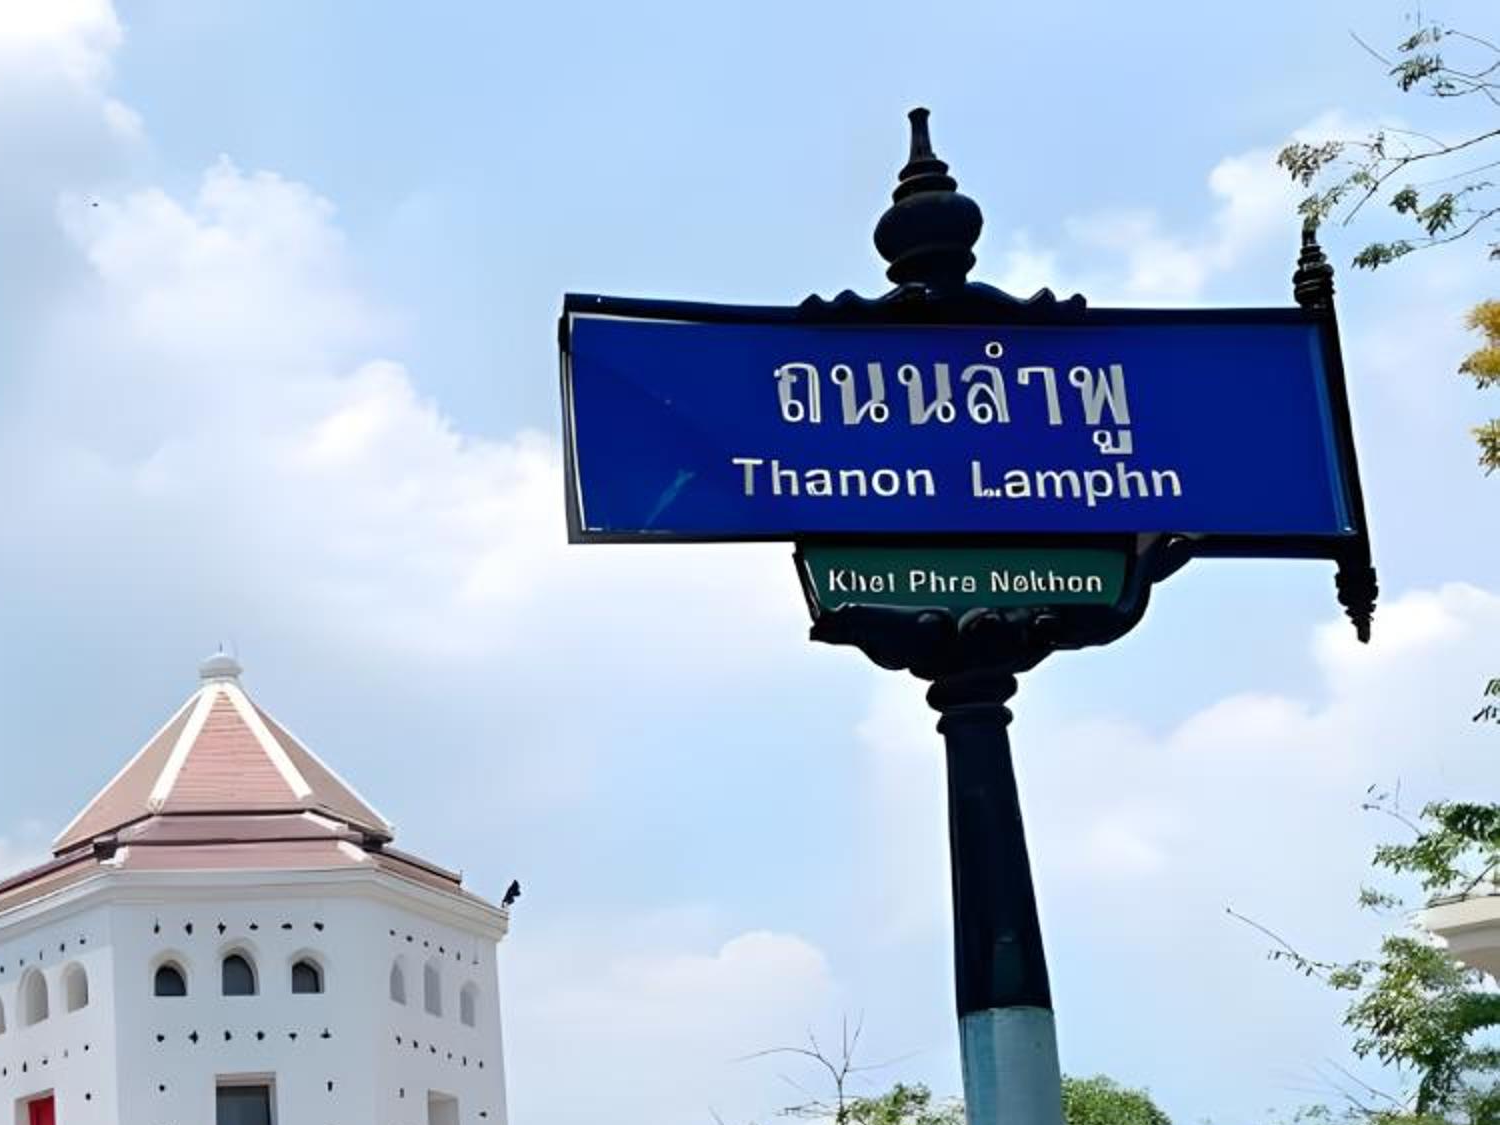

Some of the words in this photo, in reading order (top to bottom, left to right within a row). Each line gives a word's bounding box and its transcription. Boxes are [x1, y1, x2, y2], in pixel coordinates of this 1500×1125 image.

[774, 342, 1133, 454] ถนนลำพู
[732, 458, 936, 497] Thanon
